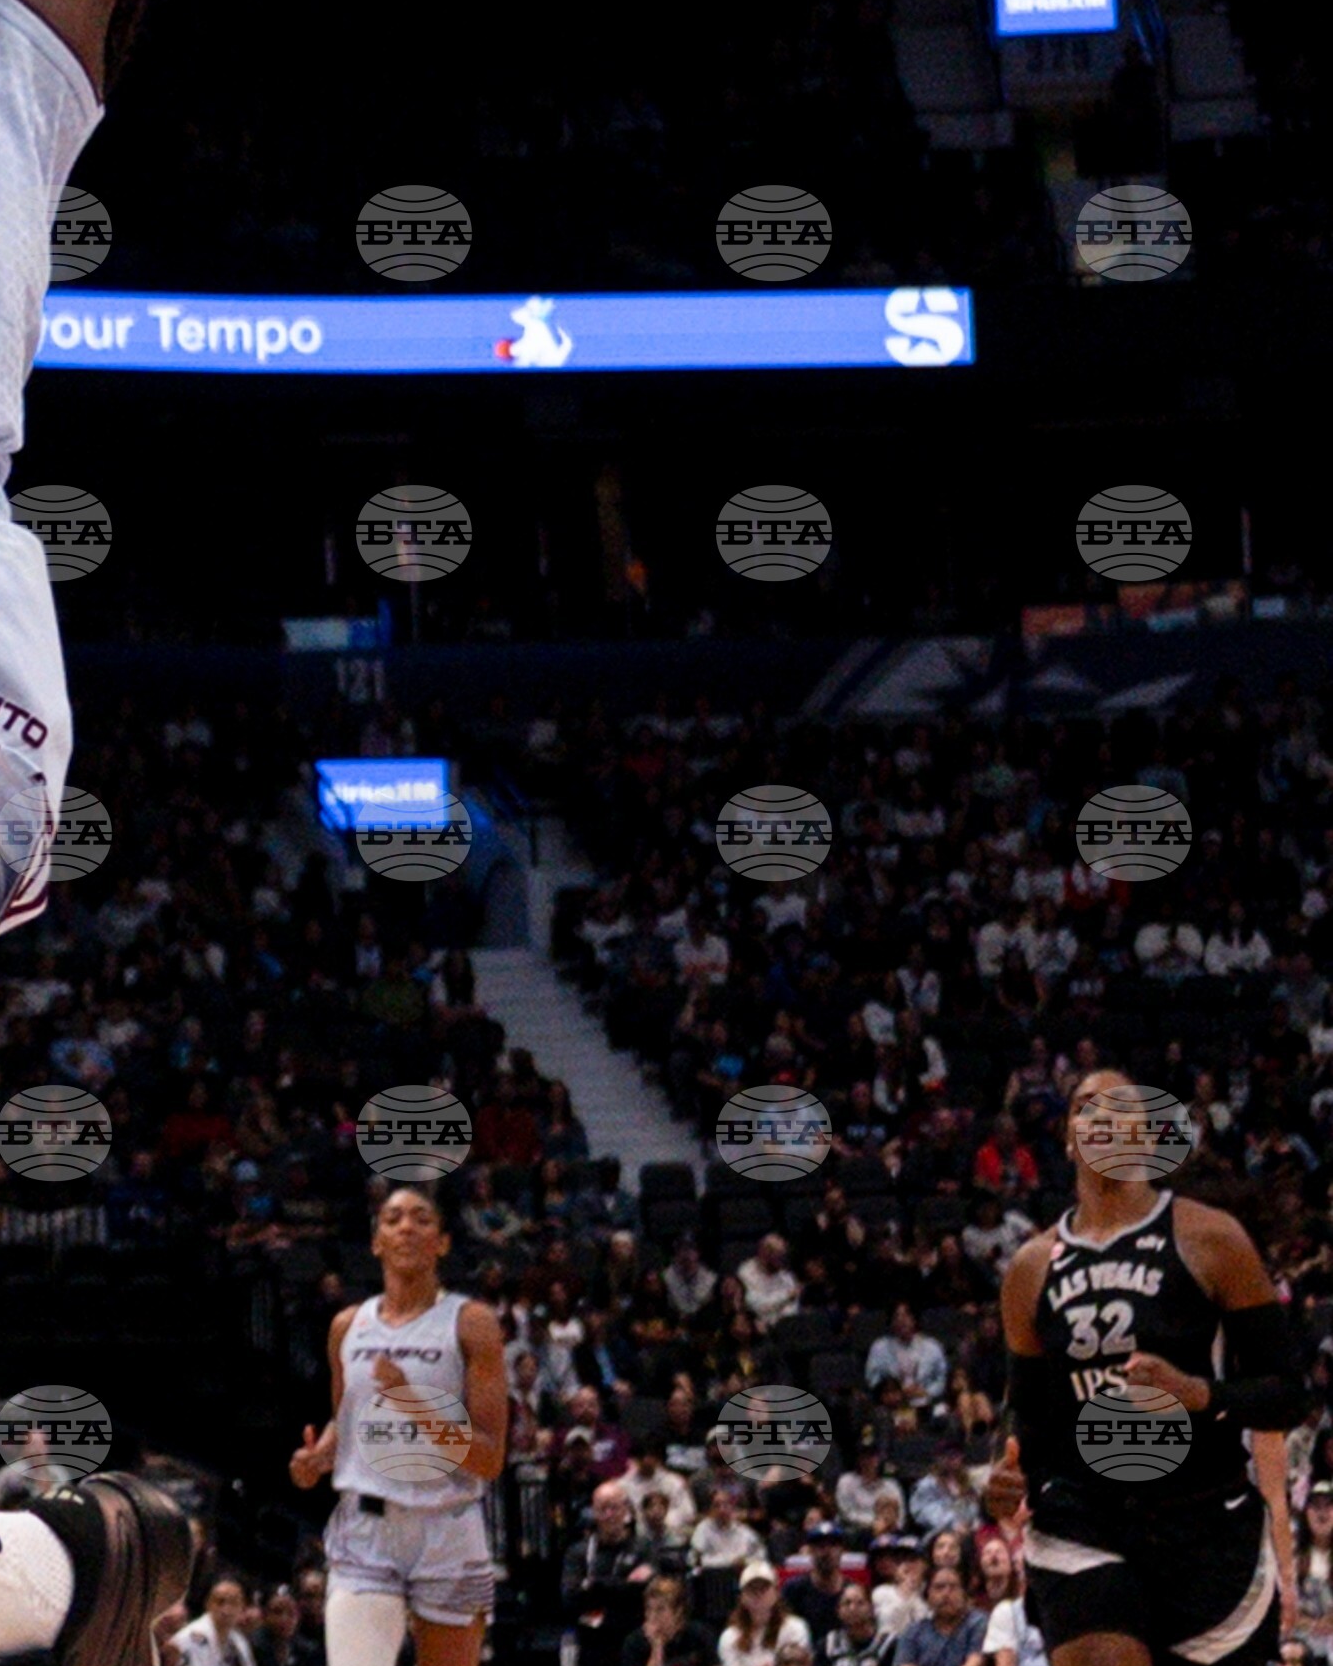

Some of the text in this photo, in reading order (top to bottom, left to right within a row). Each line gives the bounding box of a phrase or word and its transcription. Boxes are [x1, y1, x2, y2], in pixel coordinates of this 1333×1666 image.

[37, 305, 324, 364] our Tempo
[1047, 1260, 1165, 1312] LAS VEGAS
[1063, 1298, 1138, 1361] 32
[1069, 1364, 1130, 1402] IPS
